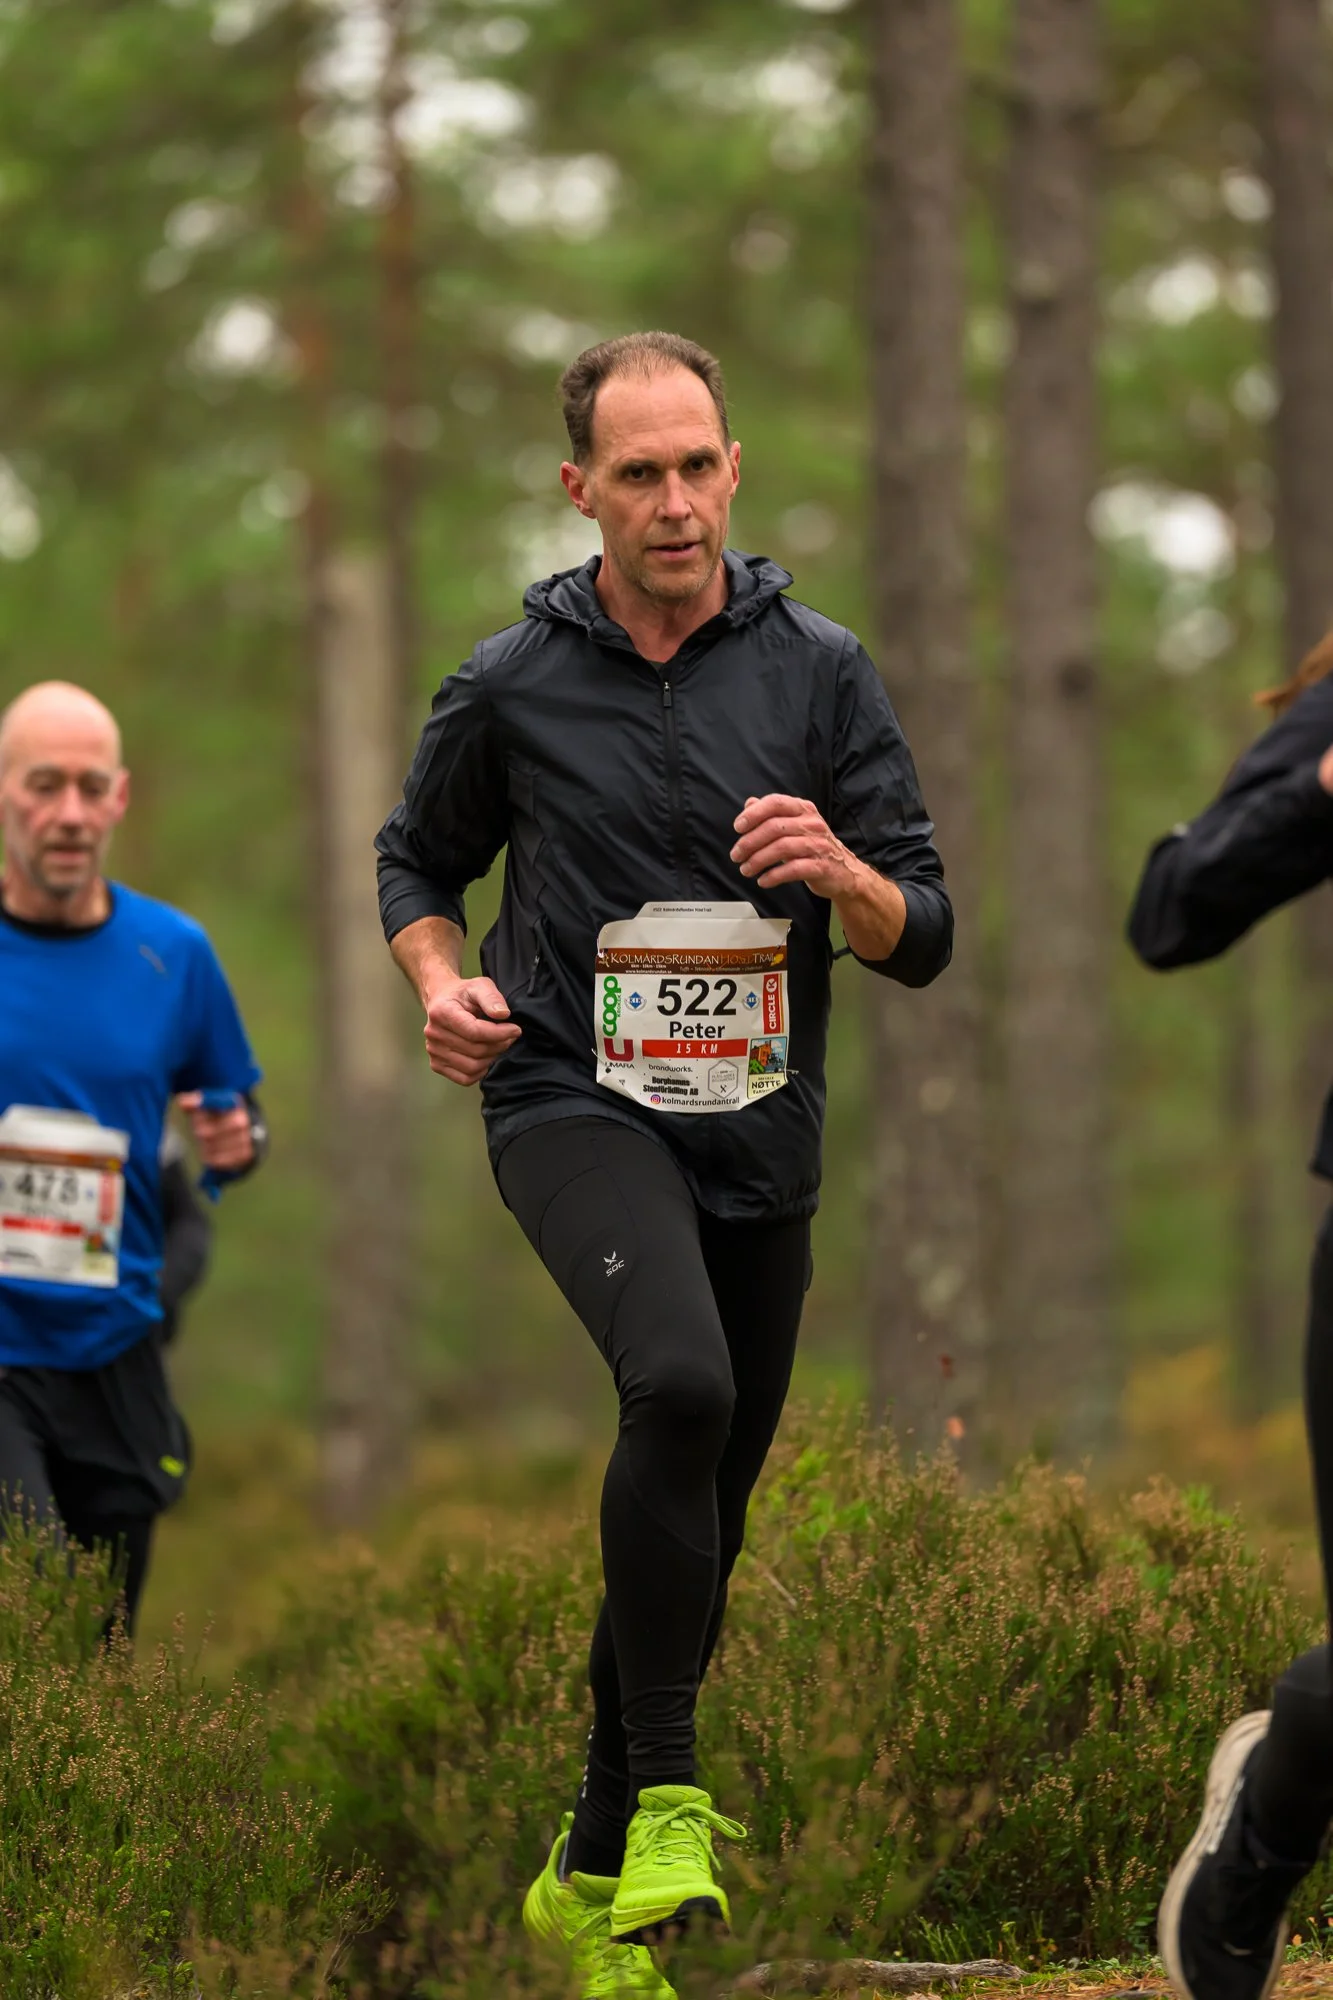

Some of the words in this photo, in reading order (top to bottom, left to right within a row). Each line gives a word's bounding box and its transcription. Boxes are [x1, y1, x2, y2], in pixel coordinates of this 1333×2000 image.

[603, 975, 622, 1037] coop
[656, 978, 738, 1017] 522
[768, 994, 777, 1030] CIRCLE
[669, 1021, 726, 1039] Peter
[662, 1096, 740, 1107] kolmardsrundantrail
